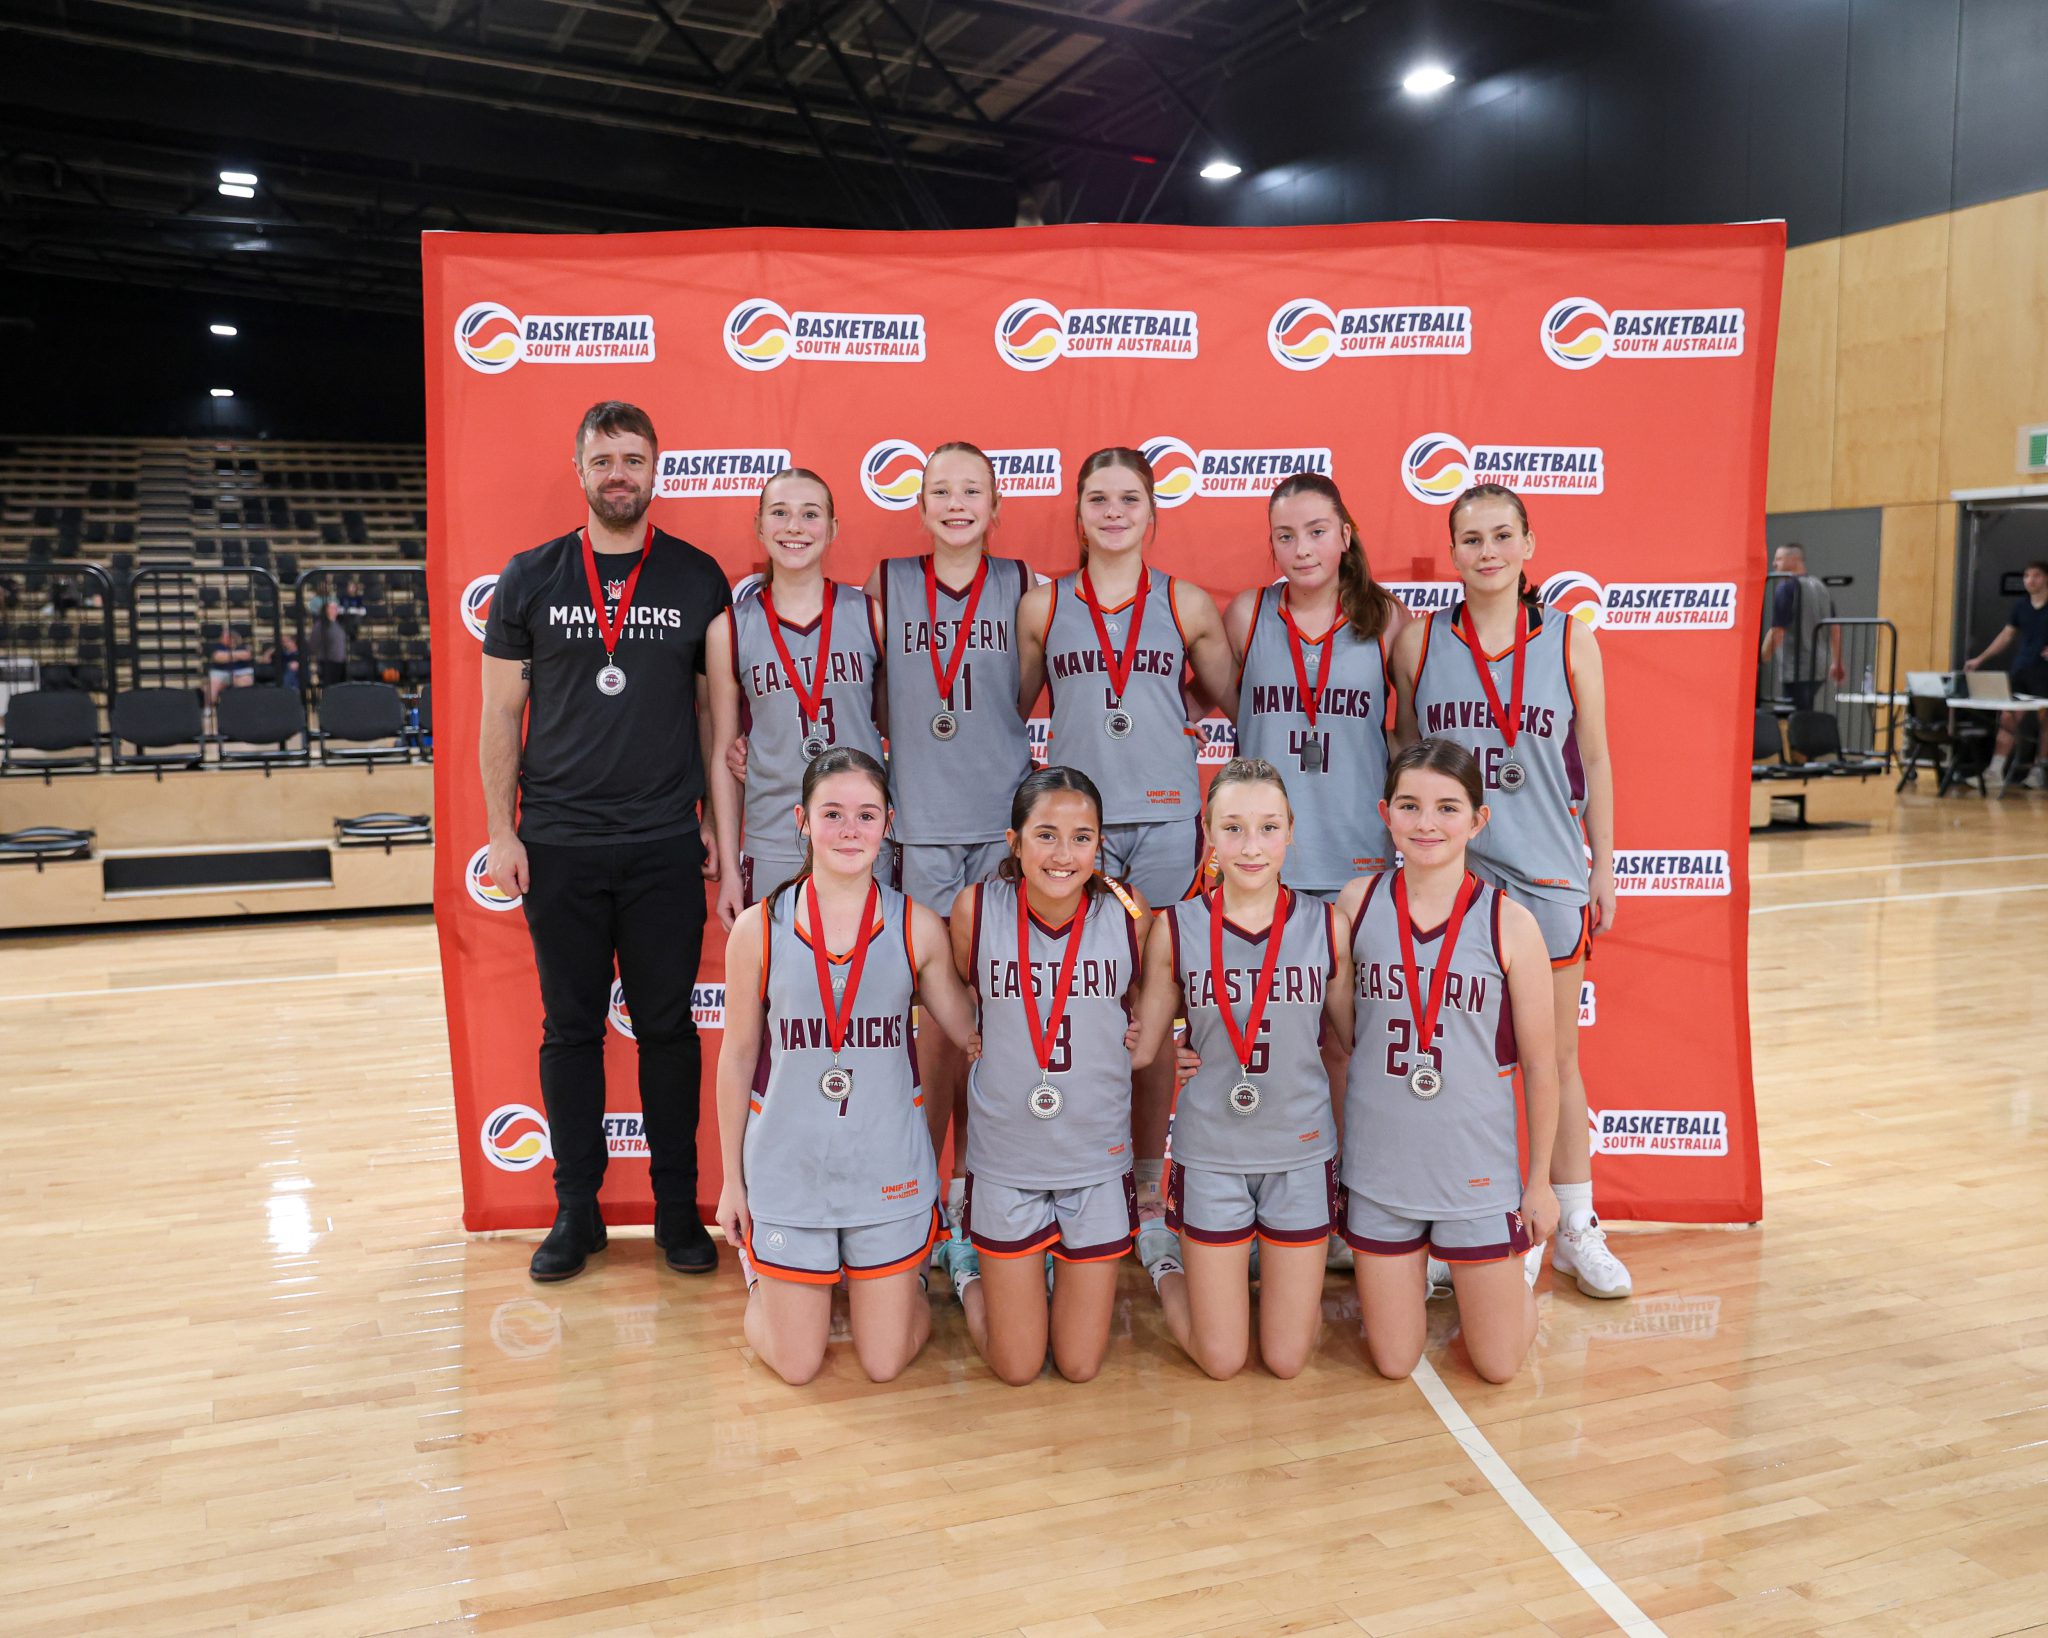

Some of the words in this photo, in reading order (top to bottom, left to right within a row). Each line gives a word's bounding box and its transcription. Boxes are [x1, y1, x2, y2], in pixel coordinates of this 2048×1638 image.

[526, 321, 649, 341] BASKETBALL
[795, 318, 919, 340] BASKETBALL
[1067, 315, 1192, 337] BASKETBALL
[1340, 312, 1465, 335] BASKETBALL
[1613, 314, 1738, 336] BASKETBALL
[525, 343, 571, 357] SOUTH
[575, 343, 649, 357] AUSTRALIA
[795, 340, 841, 354] SOUTH
[845, 341, 920, 356] AUSTRALIA
[1067, 337, 1113, 351] SOUTH
[1117, 338, 1192, 353] AUSTRALIA
[1340, 336, 1386, 351] SOUTH
[1390, 335, 1465, 349] AUSTRALIA
[1612, 338, 1658, 352] SOUTH
[1662, 337, 1737, 352] AUSTRALIA
[663, 455, 785, 476] BASKETBALL
[1202, 454, 1326, 475] BASKETBALL
[1474, 451, 1598, 473] BASKETBALL
[663, 478, 708, 492] SOUTH
[712, 477, 768, 491] AUSTRA
[1201, 477, 1247, 491] SOUTH
[1523, 474, 1598, 489] AUSTRALIA
[1606, 588, 1730, 609] BASKETBALL
[1605, 611, 1651, 624] SOUTH
[1655, 610, 1729, 624] AUSTRALIA
[1288, 730, 1330, 774] 44
[1651, 877, 1725, 890] AUSTRALIA
[1044, 1014, 1073, 1074] 3
[1245, 1019, 1271, 1075] 6
[1385, 1018, 1444, 1078] 25
[1603, 1116, 1721, 1134] BASKETBALL
[1603, 1136, 1646, 1148] SOUTH
[1650, 1137, 1722, 1150] AUSTRALIA
